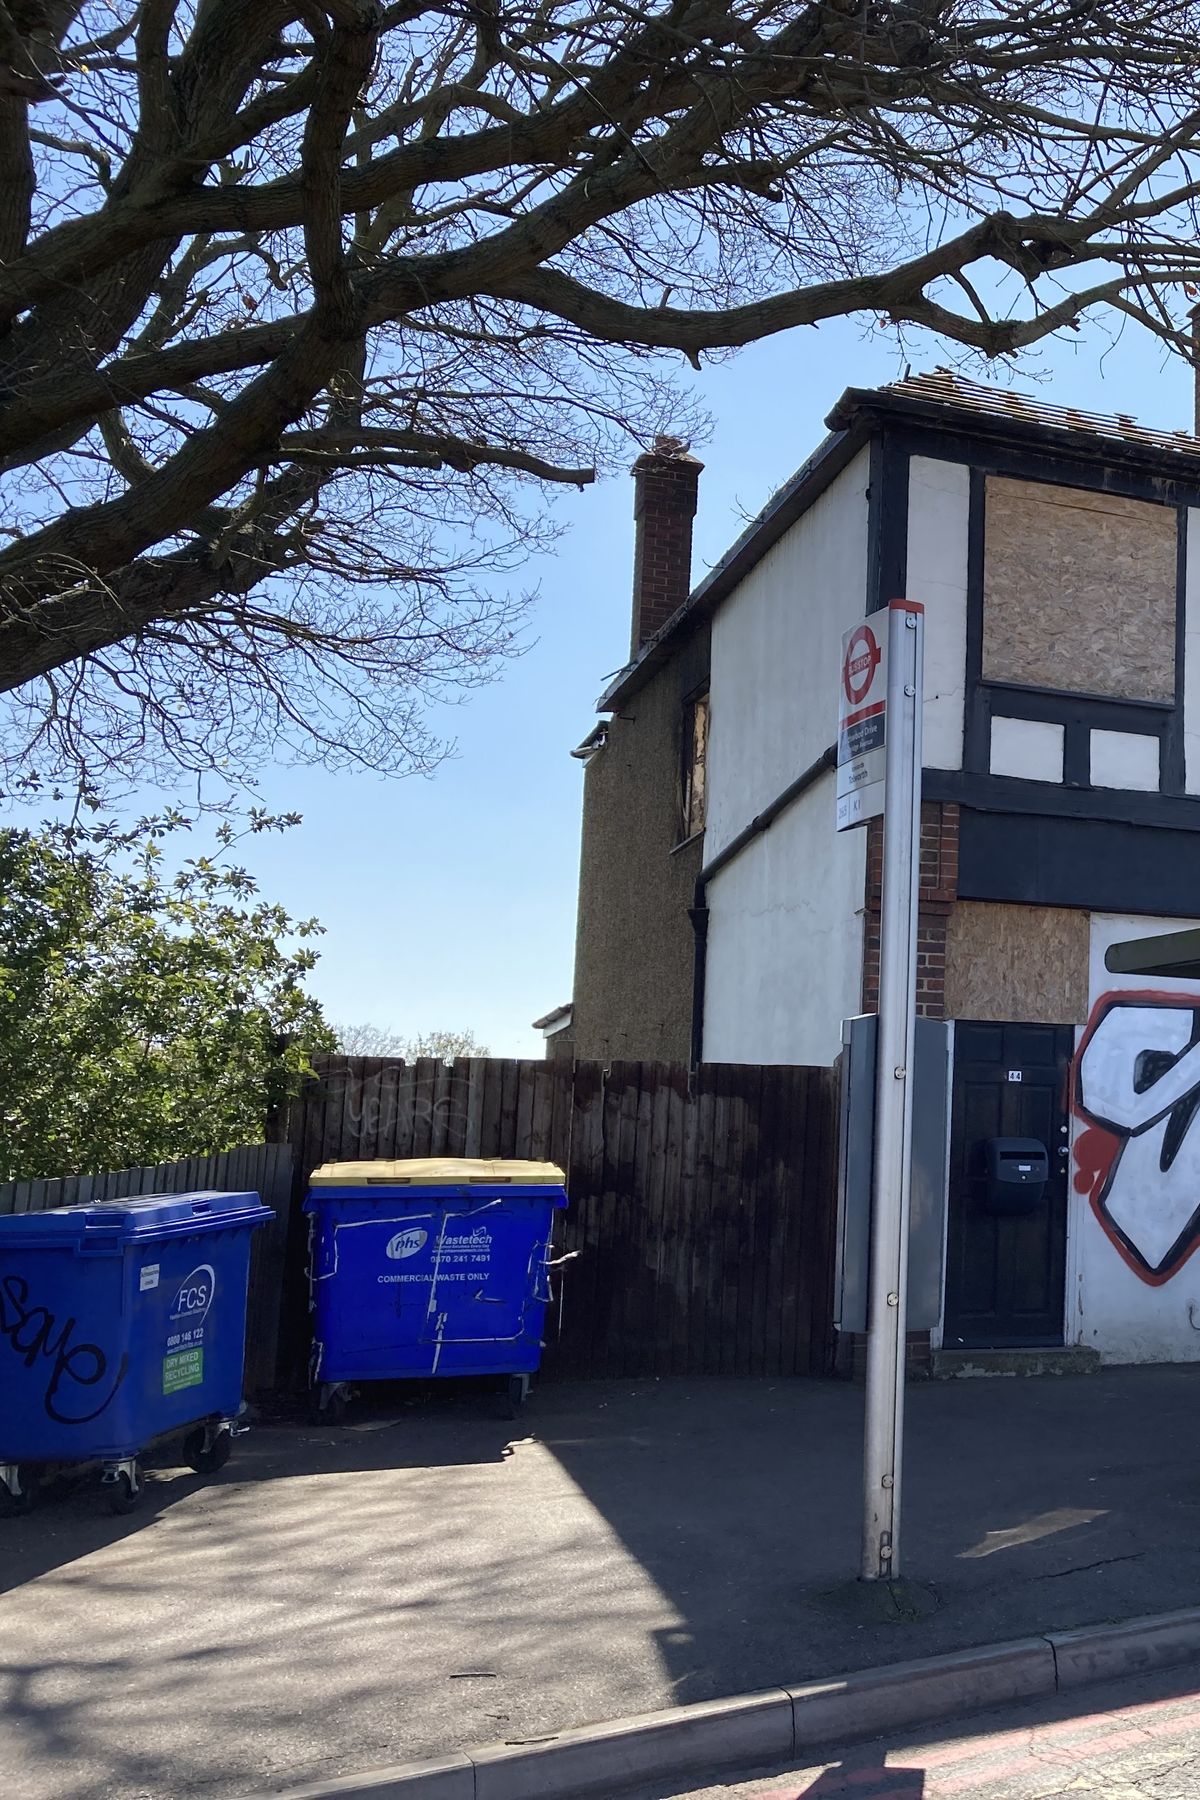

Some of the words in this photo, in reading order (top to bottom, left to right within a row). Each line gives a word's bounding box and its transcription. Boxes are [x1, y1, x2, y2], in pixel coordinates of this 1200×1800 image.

[1010, 1072, 1021, 1080] 44
[395, 1237, 420, 1251] phs
[436, 1234, 493, 1246] Wastetech
[471, 1254, 491, 1262] 7491
[377, 1274, 436, 1283] COMMERCIAL
[436, 1273, 466, 1281] WASTE
[178, 1285, 207, 1312] FCS
[167, 1337, 180, 1347] 0800
[193, 1327, 204, 1339] 122
[166, 1357, 178, 1369] DRY
[179, 1351, 199, 1365] MIXED
[164, 1362, 200, 1381] RECYCLING
